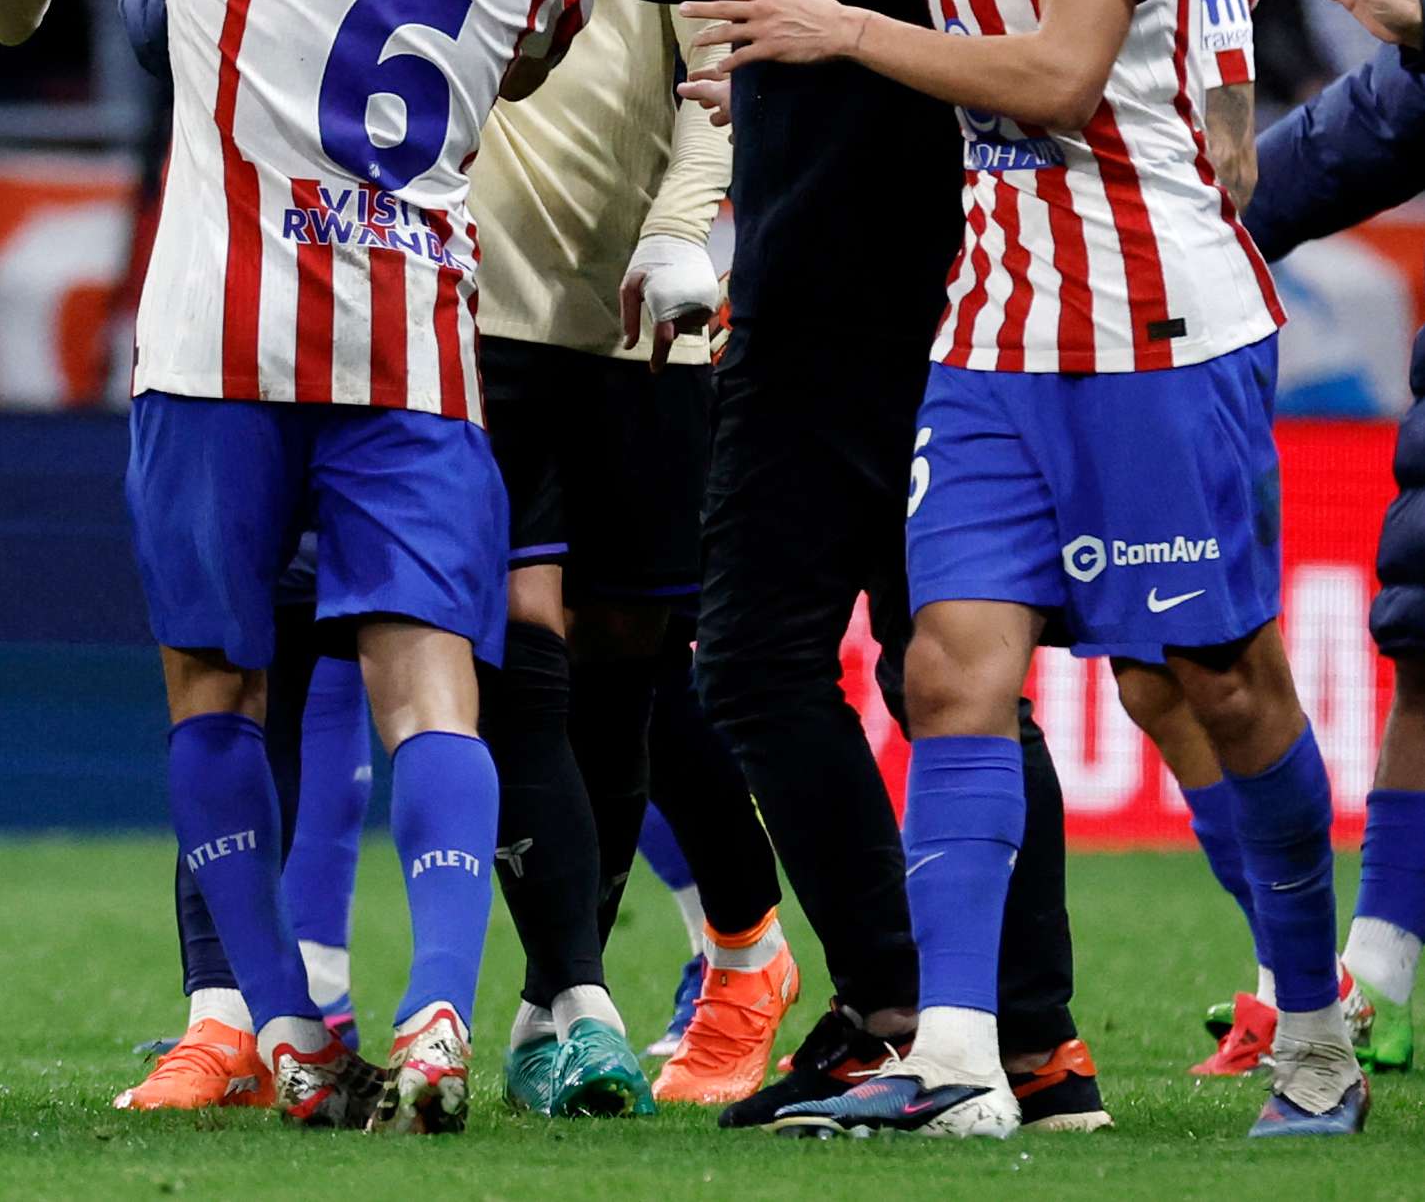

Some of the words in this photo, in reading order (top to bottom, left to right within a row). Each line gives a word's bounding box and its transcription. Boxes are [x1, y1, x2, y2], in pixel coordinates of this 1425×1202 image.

[282, 207, 475, 272] RWANDA
[1112, 535, 1221, 566] ComAve
[186, 829, 256, 873] ATLETI
[411, 849, 480, 879] ATLETI
